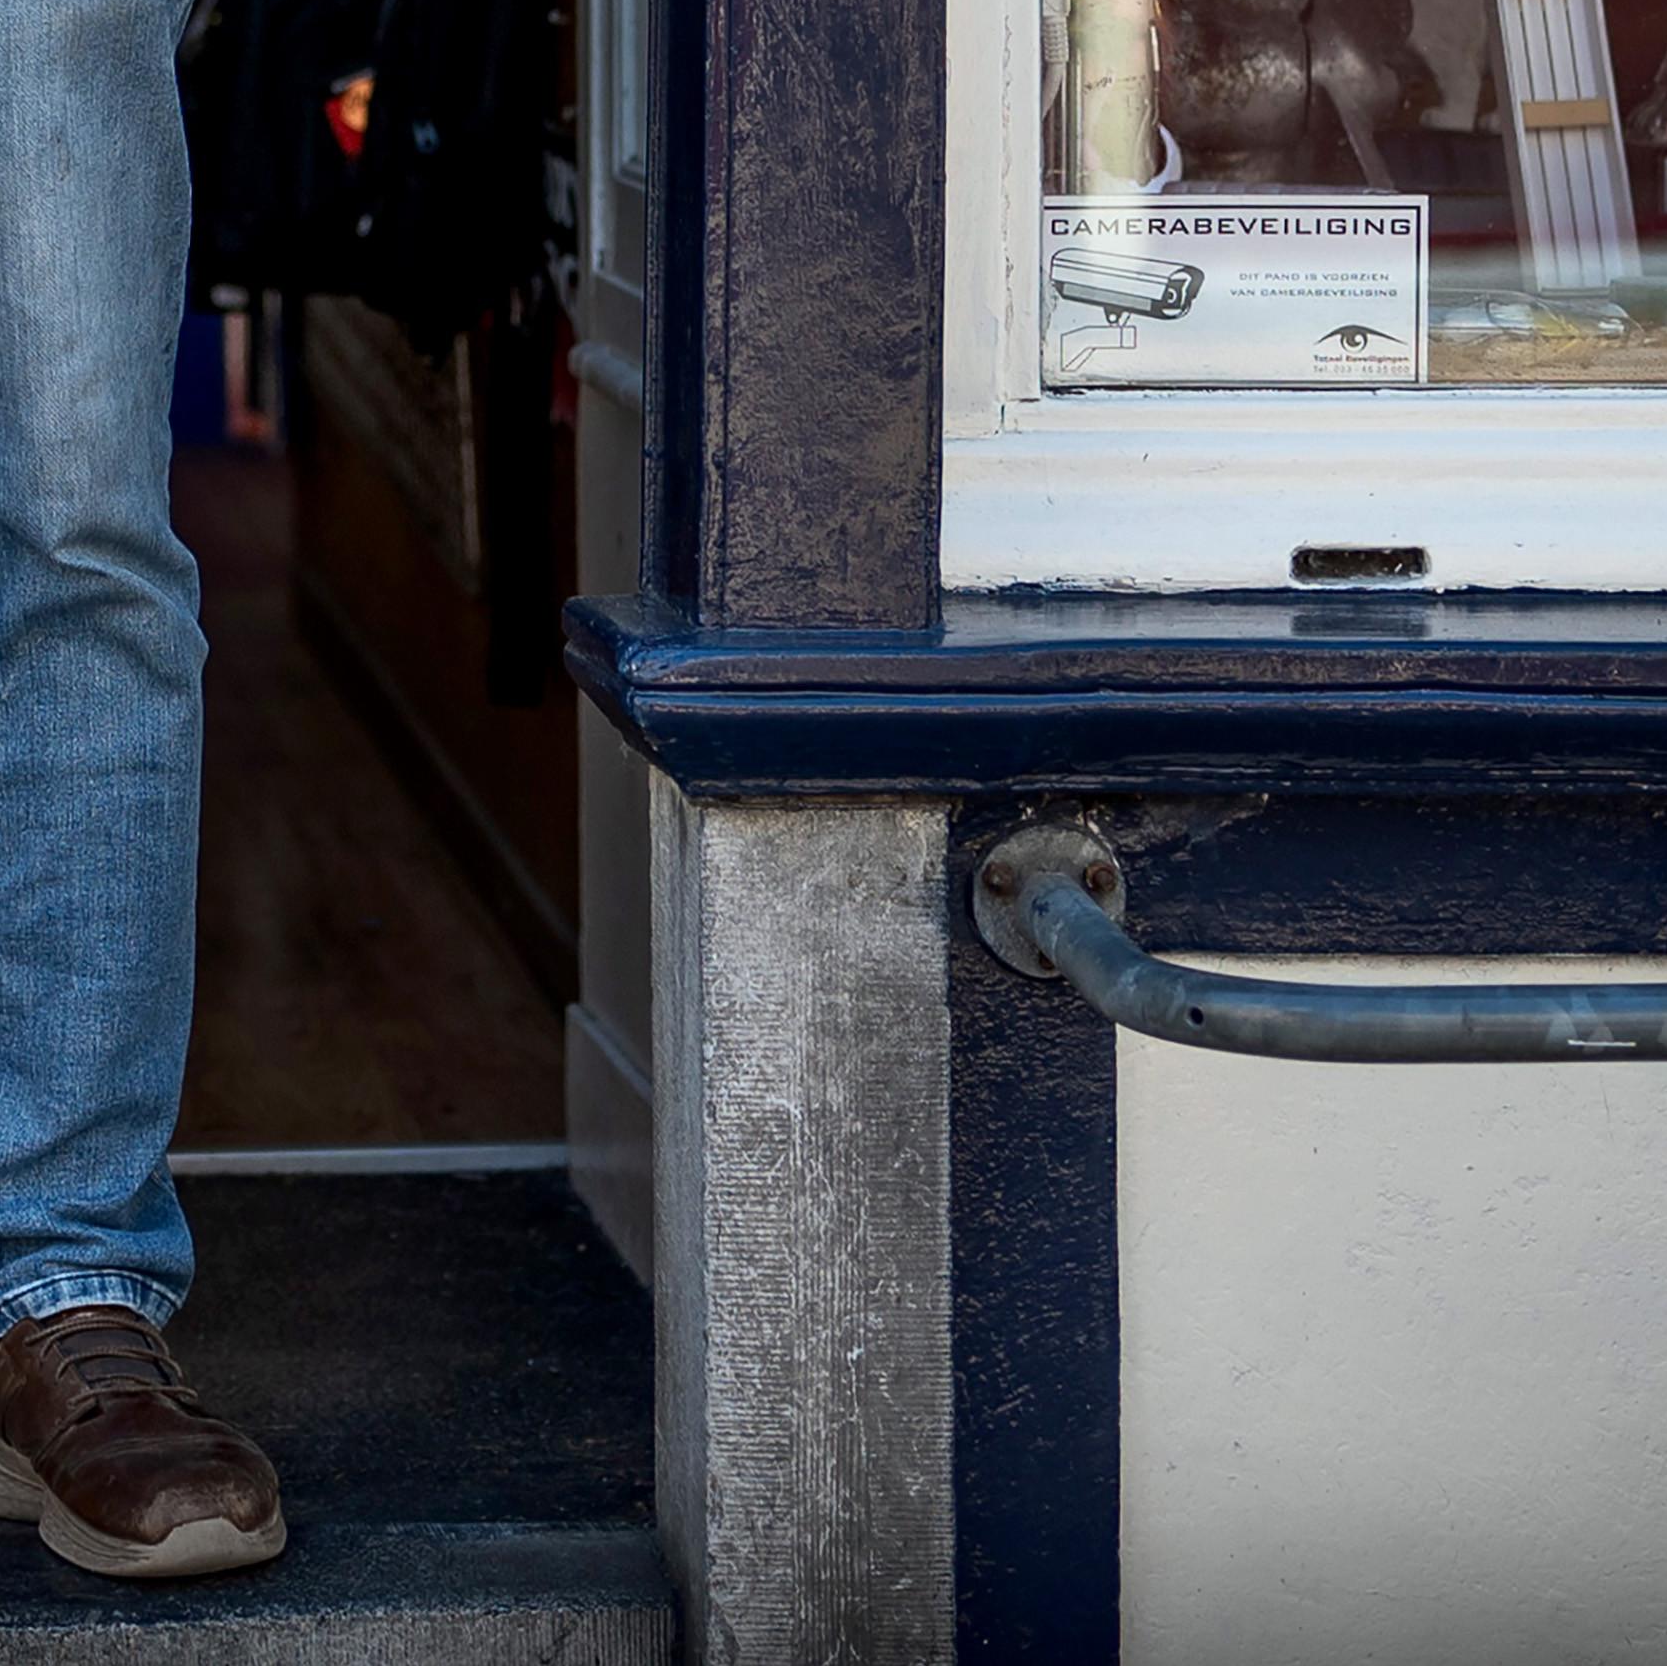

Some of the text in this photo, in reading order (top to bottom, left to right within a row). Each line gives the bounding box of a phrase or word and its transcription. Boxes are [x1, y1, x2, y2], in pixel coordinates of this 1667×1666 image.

[1049, 218, 1412, 236] CAMERABEVEILIGING
[1264, 273, 1300, 281] PAND
[1305, 273, 1318, 281] IS
[1322, 273, 1390, 282] VOORZIEN
[1230, 288, 1255, 297] VAN
